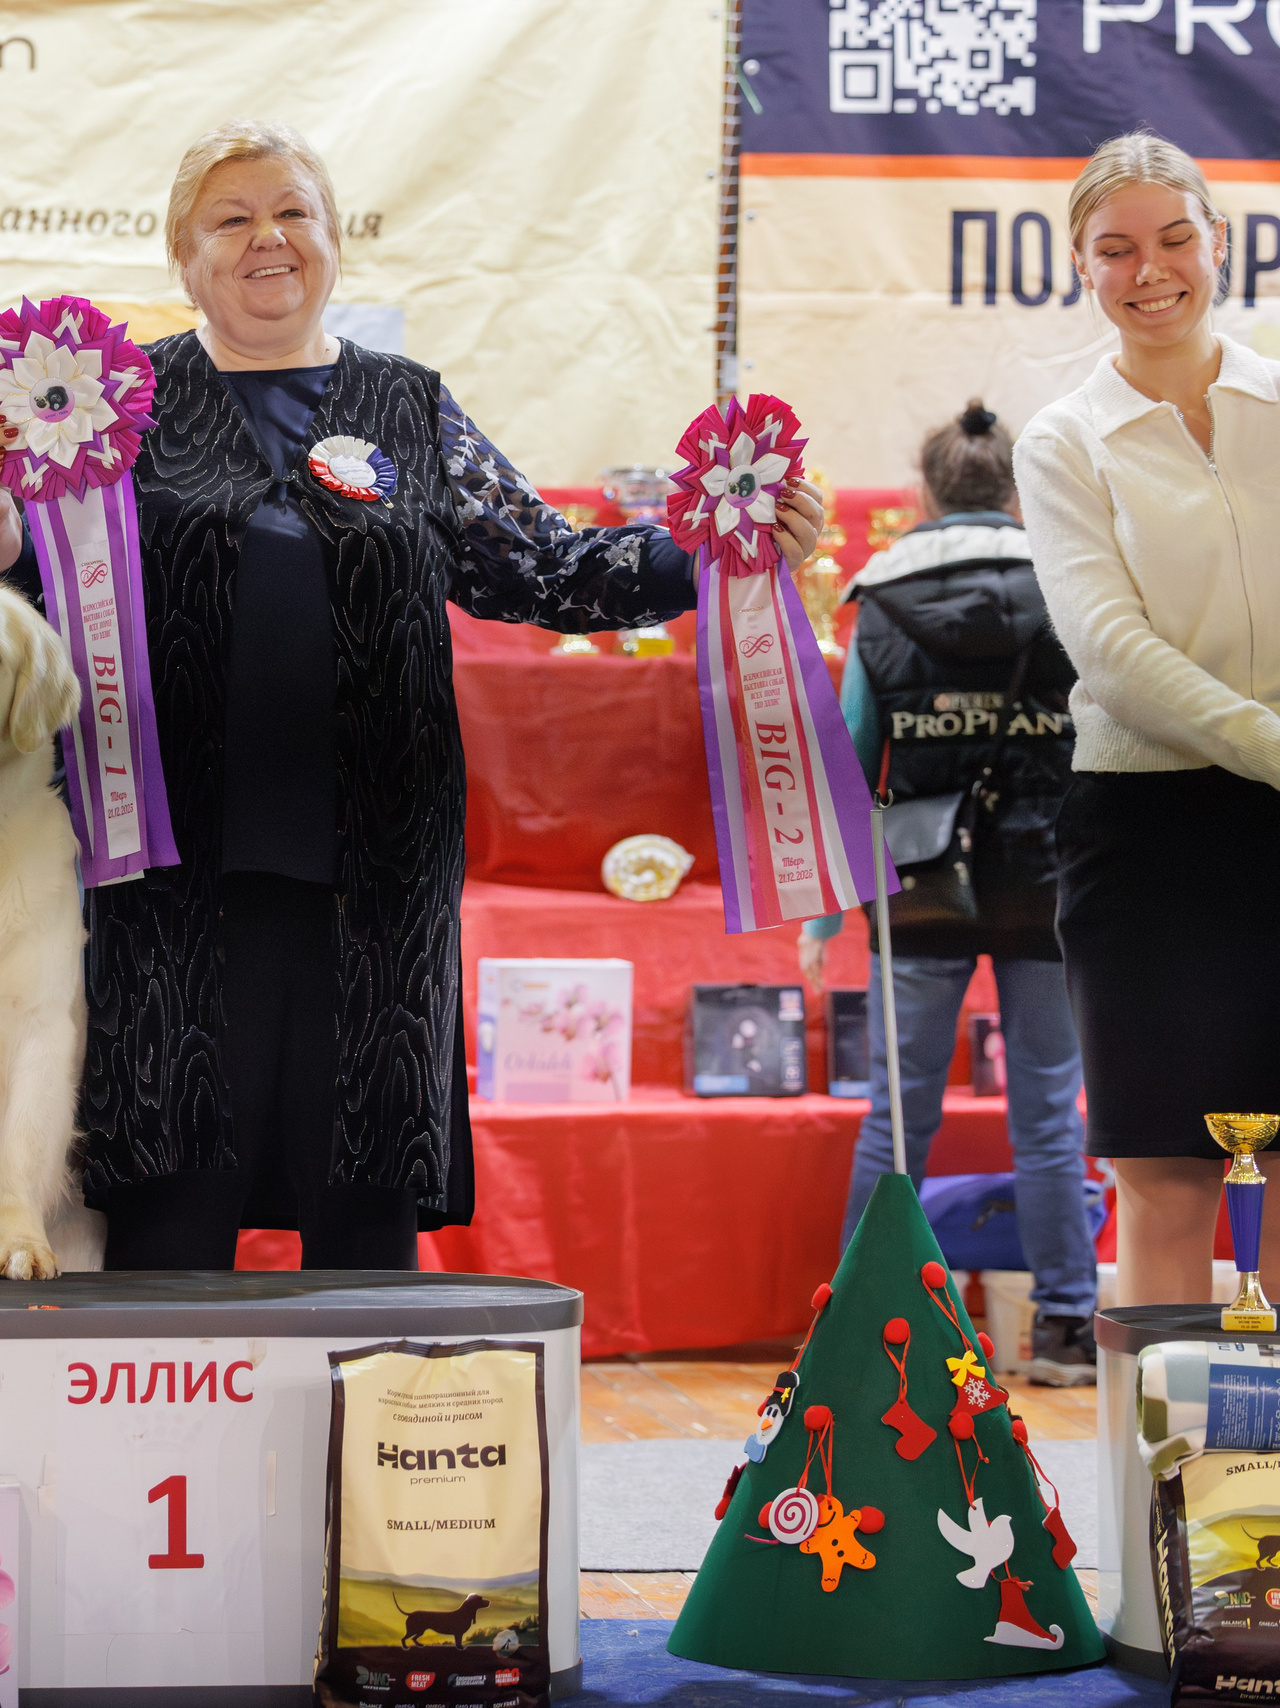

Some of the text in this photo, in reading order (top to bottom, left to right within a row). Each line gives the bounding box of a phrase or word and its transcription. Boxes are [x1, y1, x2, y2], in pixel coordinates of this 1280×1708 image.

[1082, 0, 1280, 56] PR
[92, 652, 123, 725] BIG
[754, 720, 796, 792] BIG
[104, 762, 127, 777] 1
[774, 828, 804, 845] 2
[782, 856, 805, 869] Тверь
[67, 1360, 254, 1404] ЭЛЛИС
[414, 1389, 476, 1400] полнорационный
[477, 1389, 490, 1397] для
[418, 1400, 445, 1409] мелких
[452, 1399, 481, 1409] средних
[482, 1396, 504, 1405] пород
[397, 1412, 443, 1424] говядиной
[444, 1414, 451, 1422] и
[452, 1411, 483, 1424] рисом
[377, 1441, 507, 1471] Hanta
[1226, 1460, 1280, 1476] SMALL/
[410, 1474, 466, 1486] premium
[147, 1475, 205, 1570] 1
[386, 1518, 496, 1532] SMALL/MEDIUM
[411, 1674, 431, 1682] FRESH
